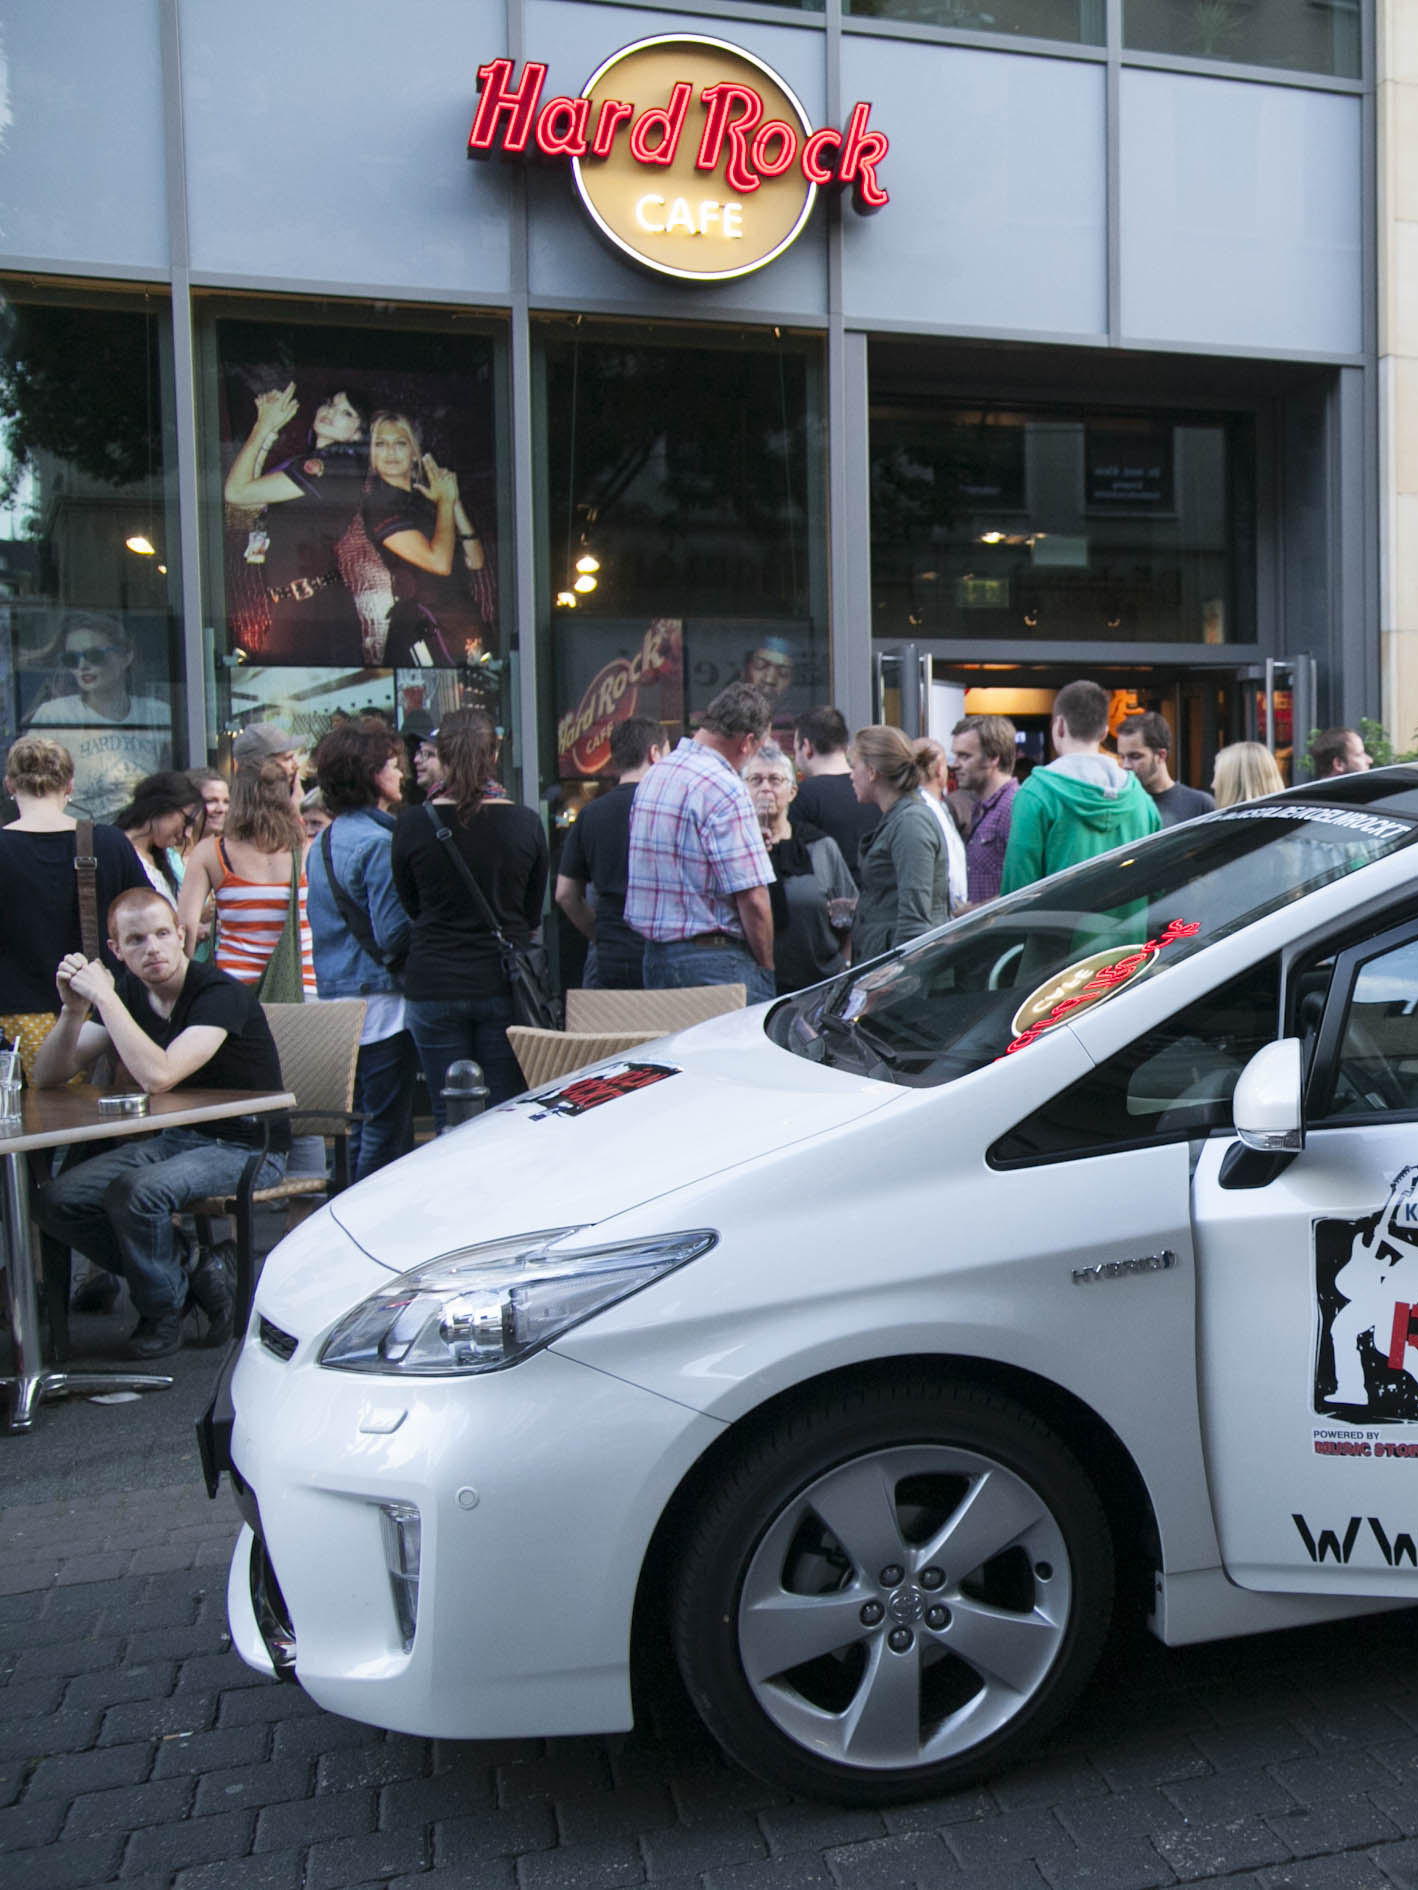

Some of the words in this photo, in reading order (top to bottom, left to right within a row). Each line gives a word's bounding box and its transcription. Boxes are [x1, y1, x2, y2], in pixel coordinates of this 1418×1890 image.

[468, 58, 693, 166] Hard
[697, 82, 889, 206] Rock
[635, 193, 744, 239] CAFE
[1313, 1430, 1364, 1440] POWERED
[1366, 1431, 1380, 1440] BY
[1314, 1441, 1372, 1457] MUSIC
